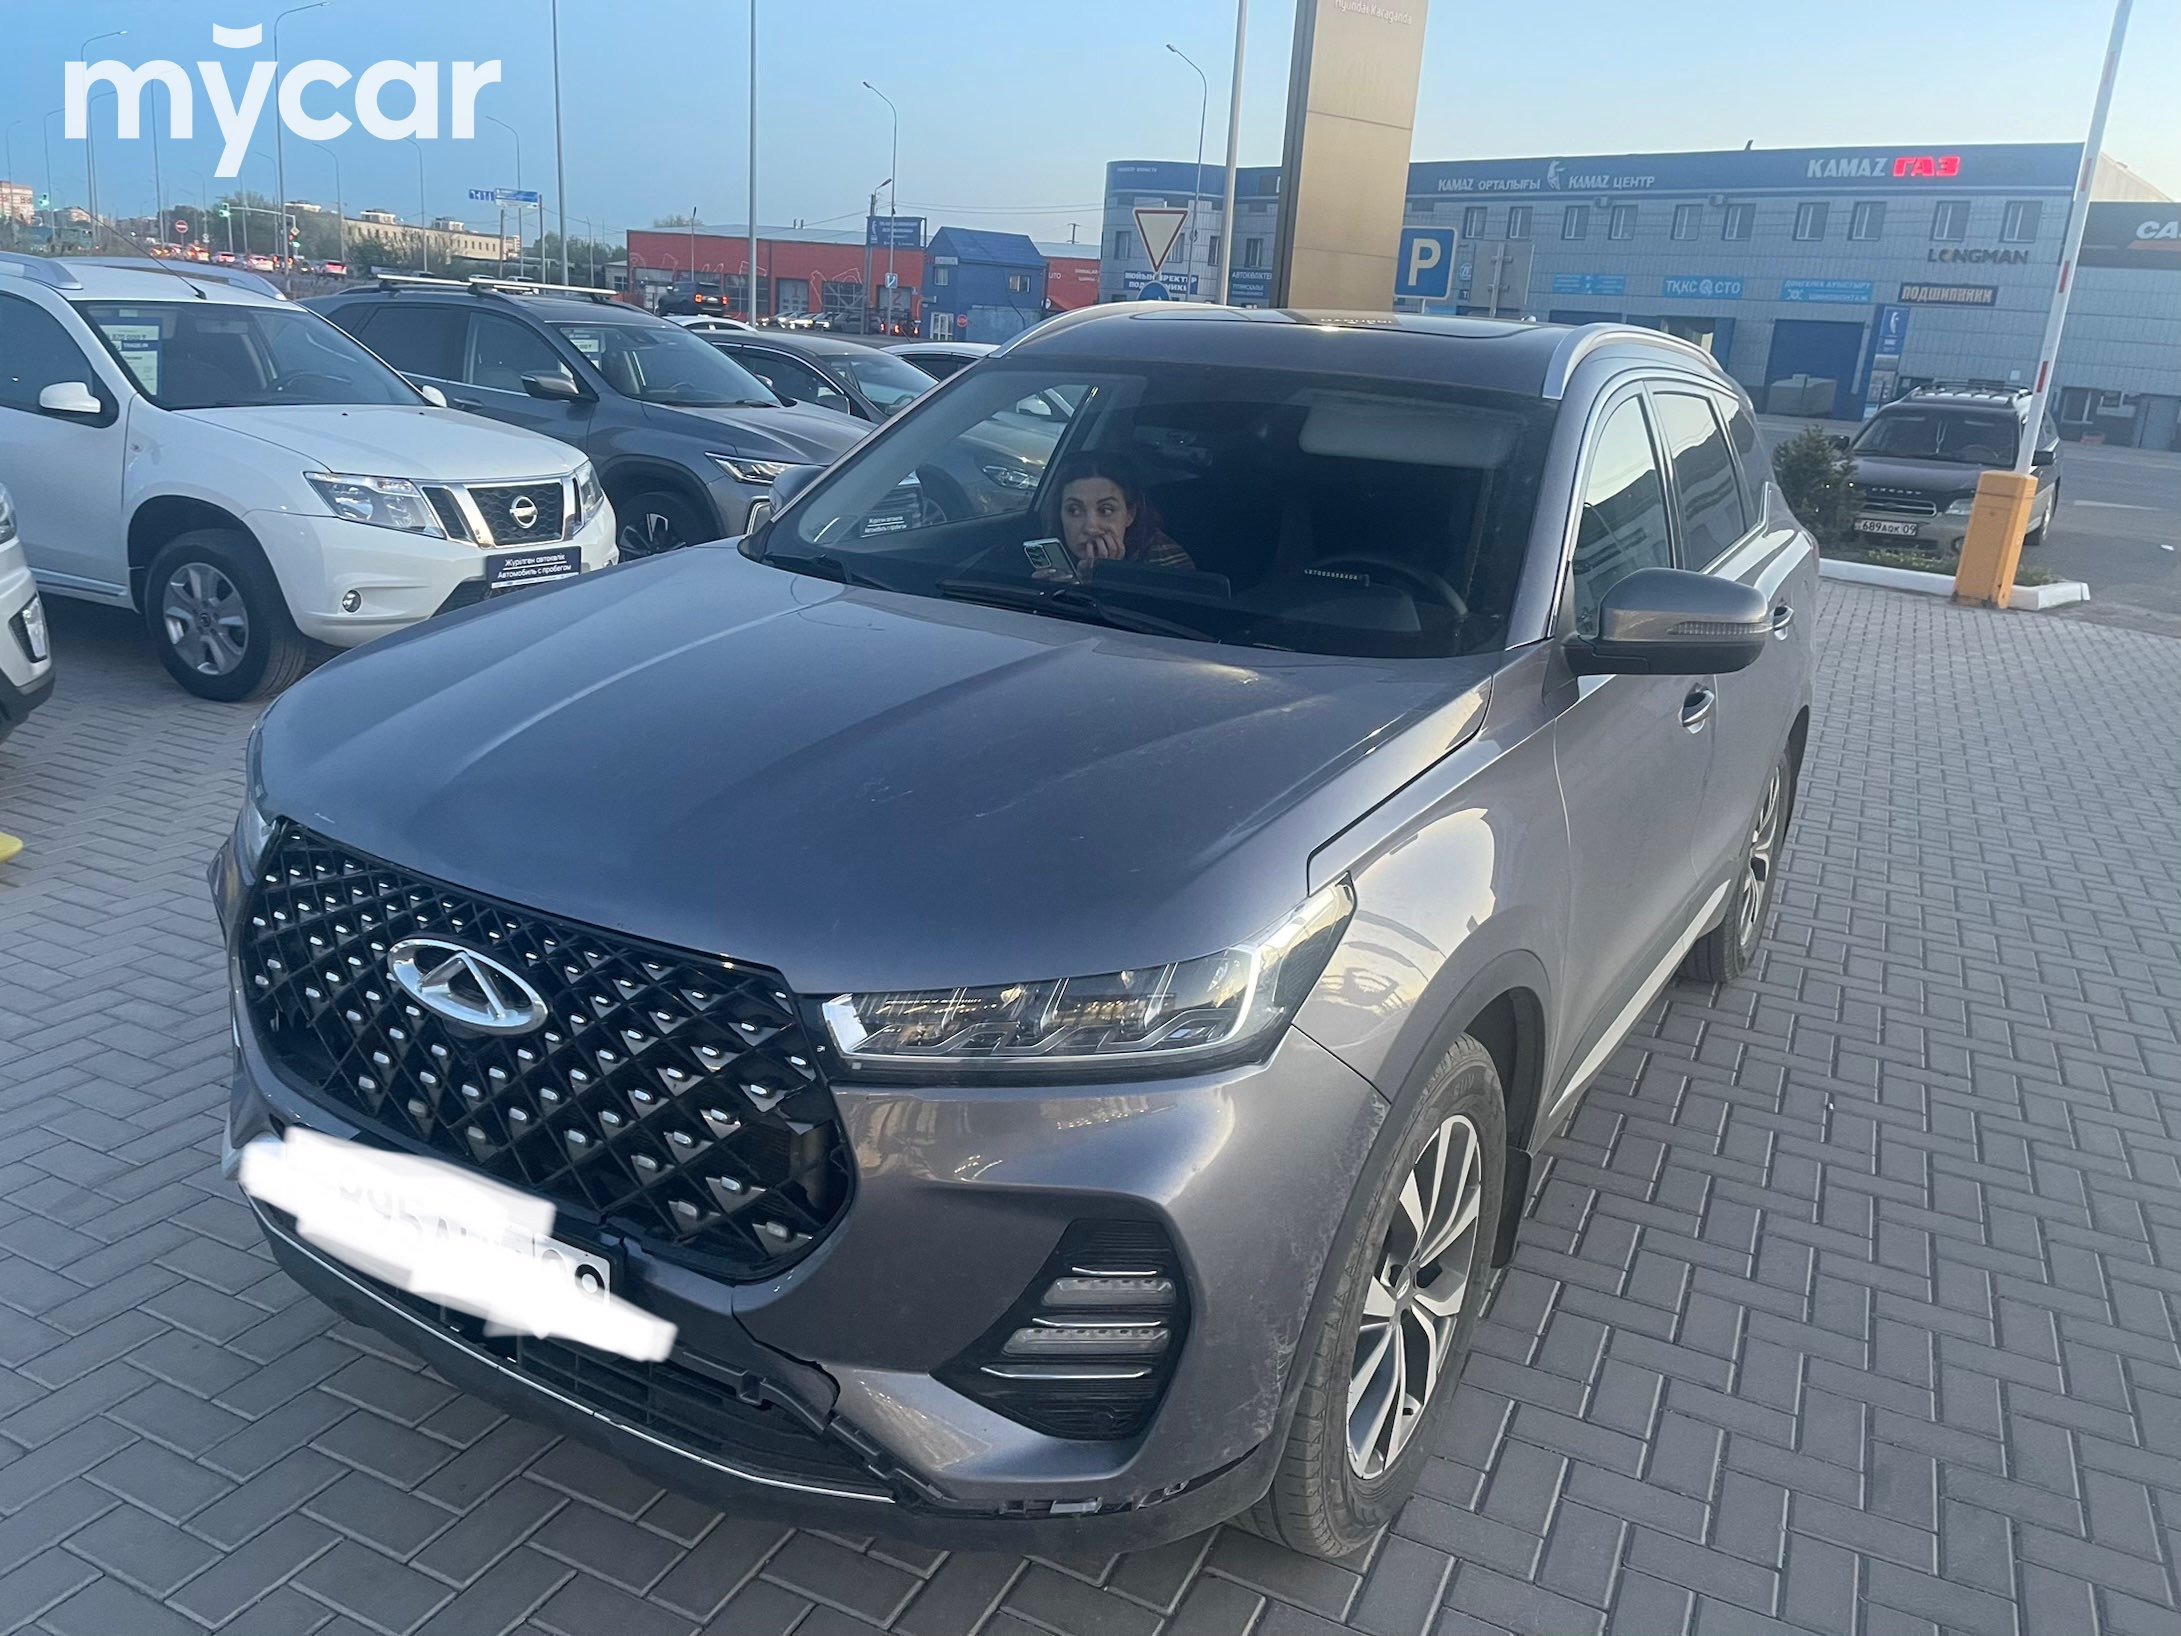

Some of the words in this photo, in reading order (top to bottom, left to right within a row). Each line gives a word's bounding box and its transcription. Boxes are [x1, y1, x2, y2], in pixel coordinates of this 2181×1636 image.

[1807, 157, 1888, 178] KAMAZ
[1892, 155, 1962, 178] ГАЗ
[1438, 178, 1474, 192] KAMAZ
[1568, 175, 1610, 189] KAMAZ
[1613, 176, 1655, 189] ЦЕНТР
[2136, 220, 2181, 239] CA
[1408, 238, 1441, 286] P
[1927, 249, 2029, 265] LONGMAN
[1714, 281, 1741, 295] СТО
[1901, 285, 1994, 303] ПОДШИПНИКИ
[497, 567, 537, 579] Автомобиль
[543, 564, 572, 575] пробегом
